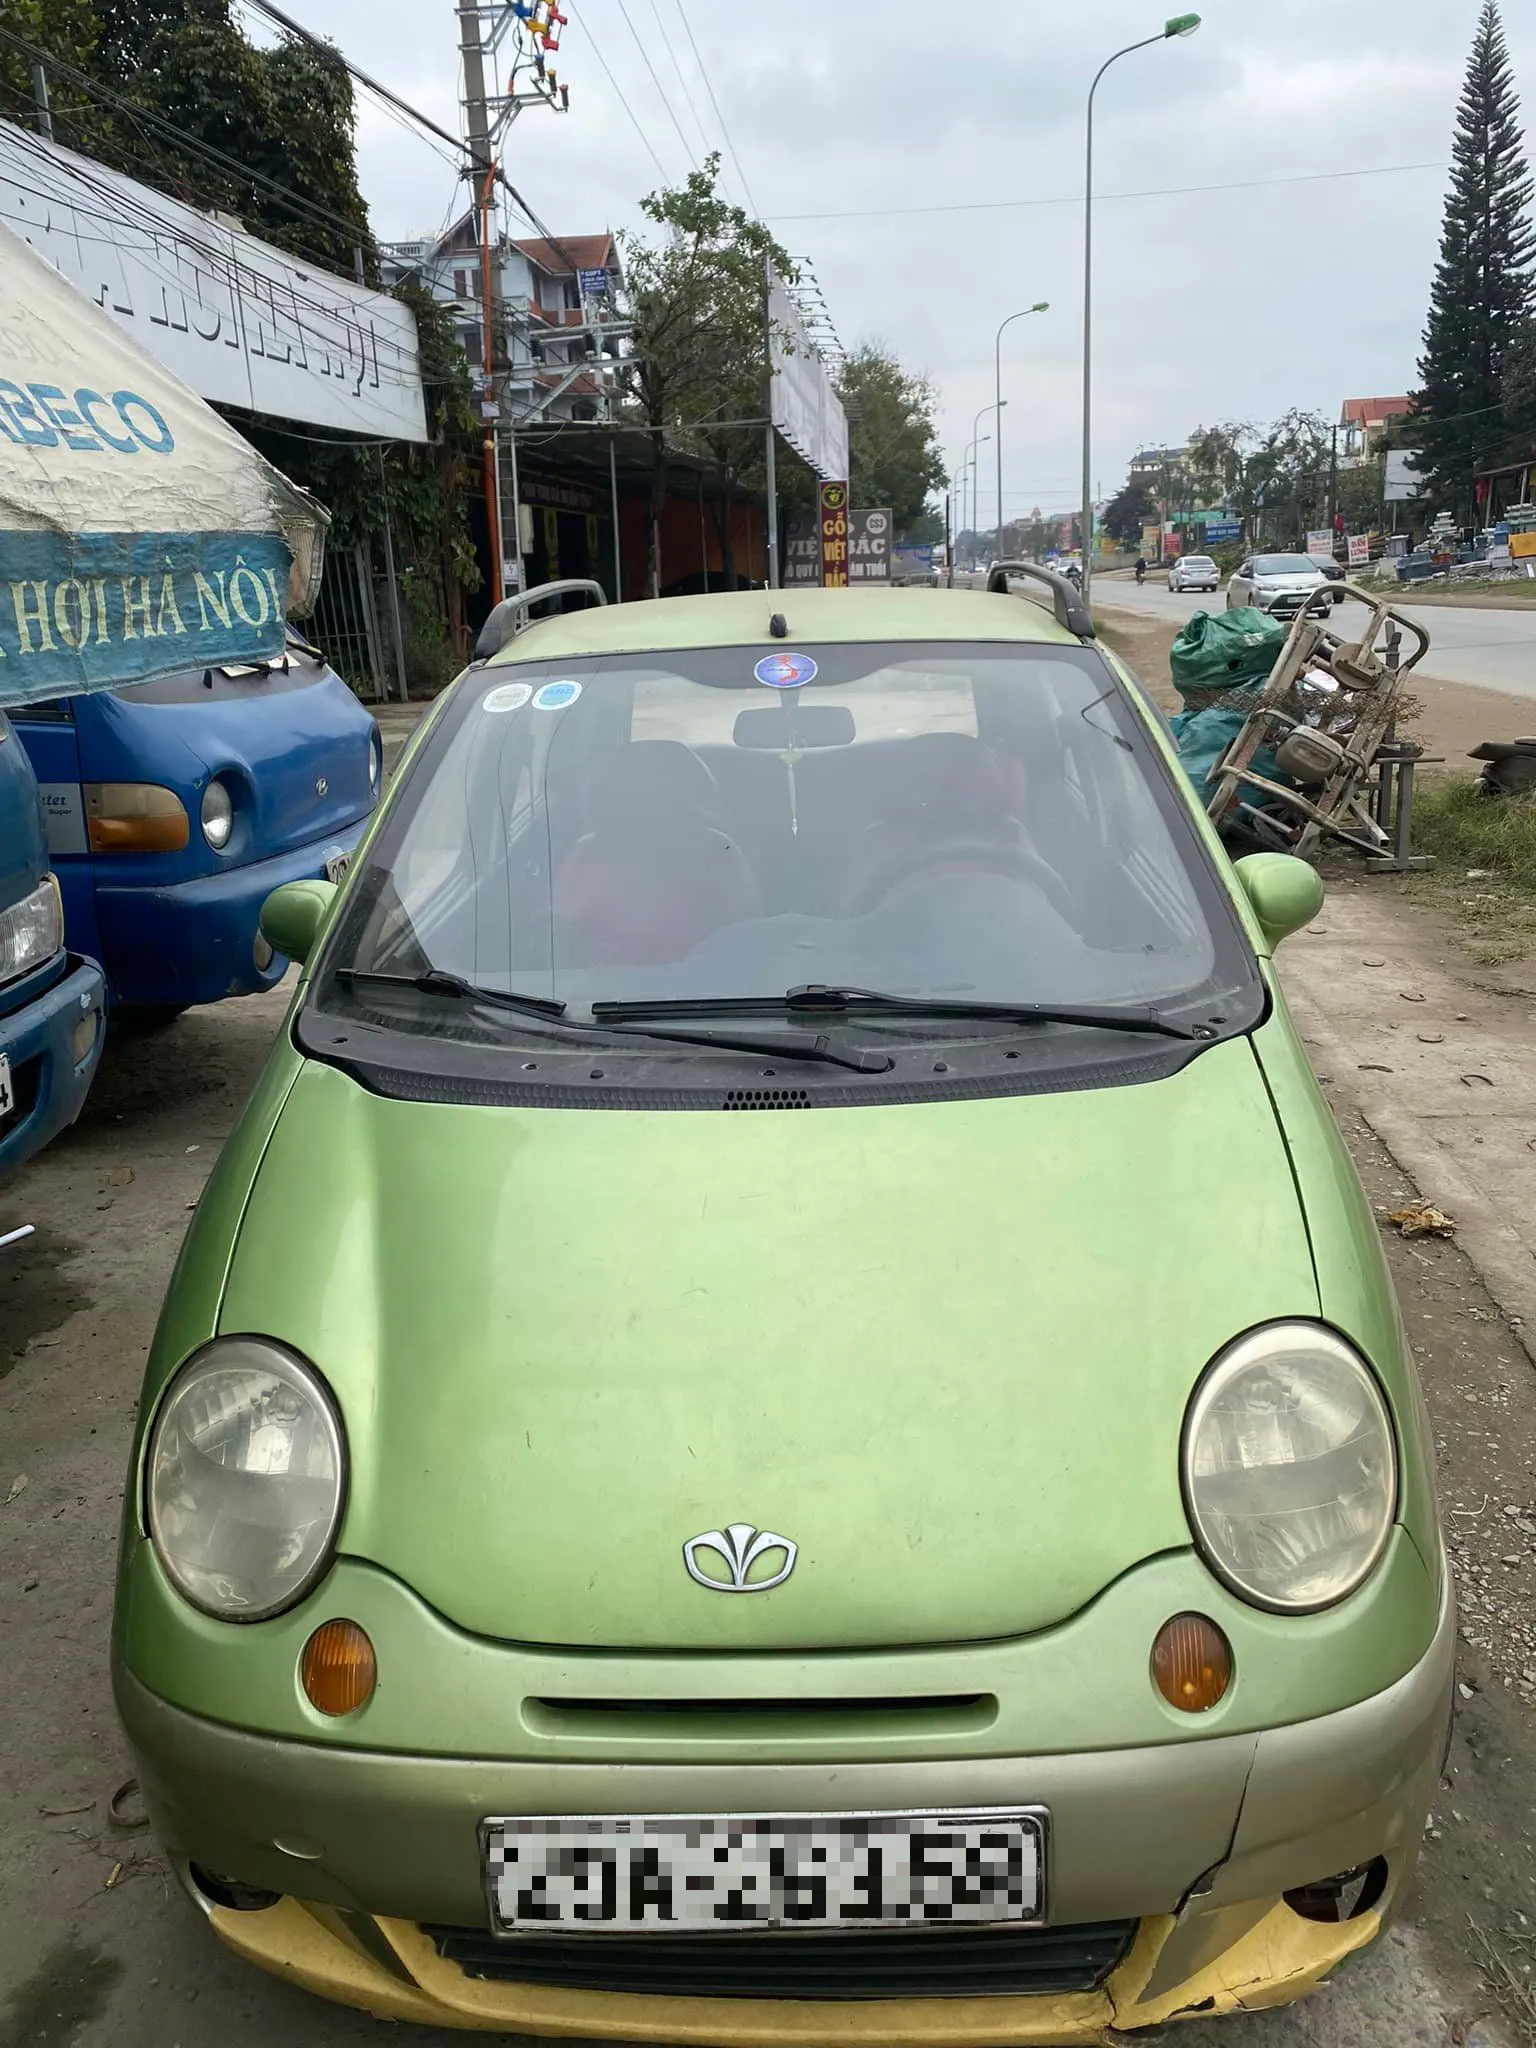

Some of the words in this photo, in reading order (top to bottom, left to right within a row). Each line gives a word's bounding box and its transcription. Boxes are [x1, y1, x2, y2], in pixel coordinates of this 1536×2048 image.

[823, 511, 846, 536] GỖ
[787, 536, 818, 559] VIỆ
[824, 538, 846, 565] VIỆT
[8, 577, 111, 655] HƠI
[120, 555, 188, 641] HÀ
[192, 554, 283, 638] NỘI
